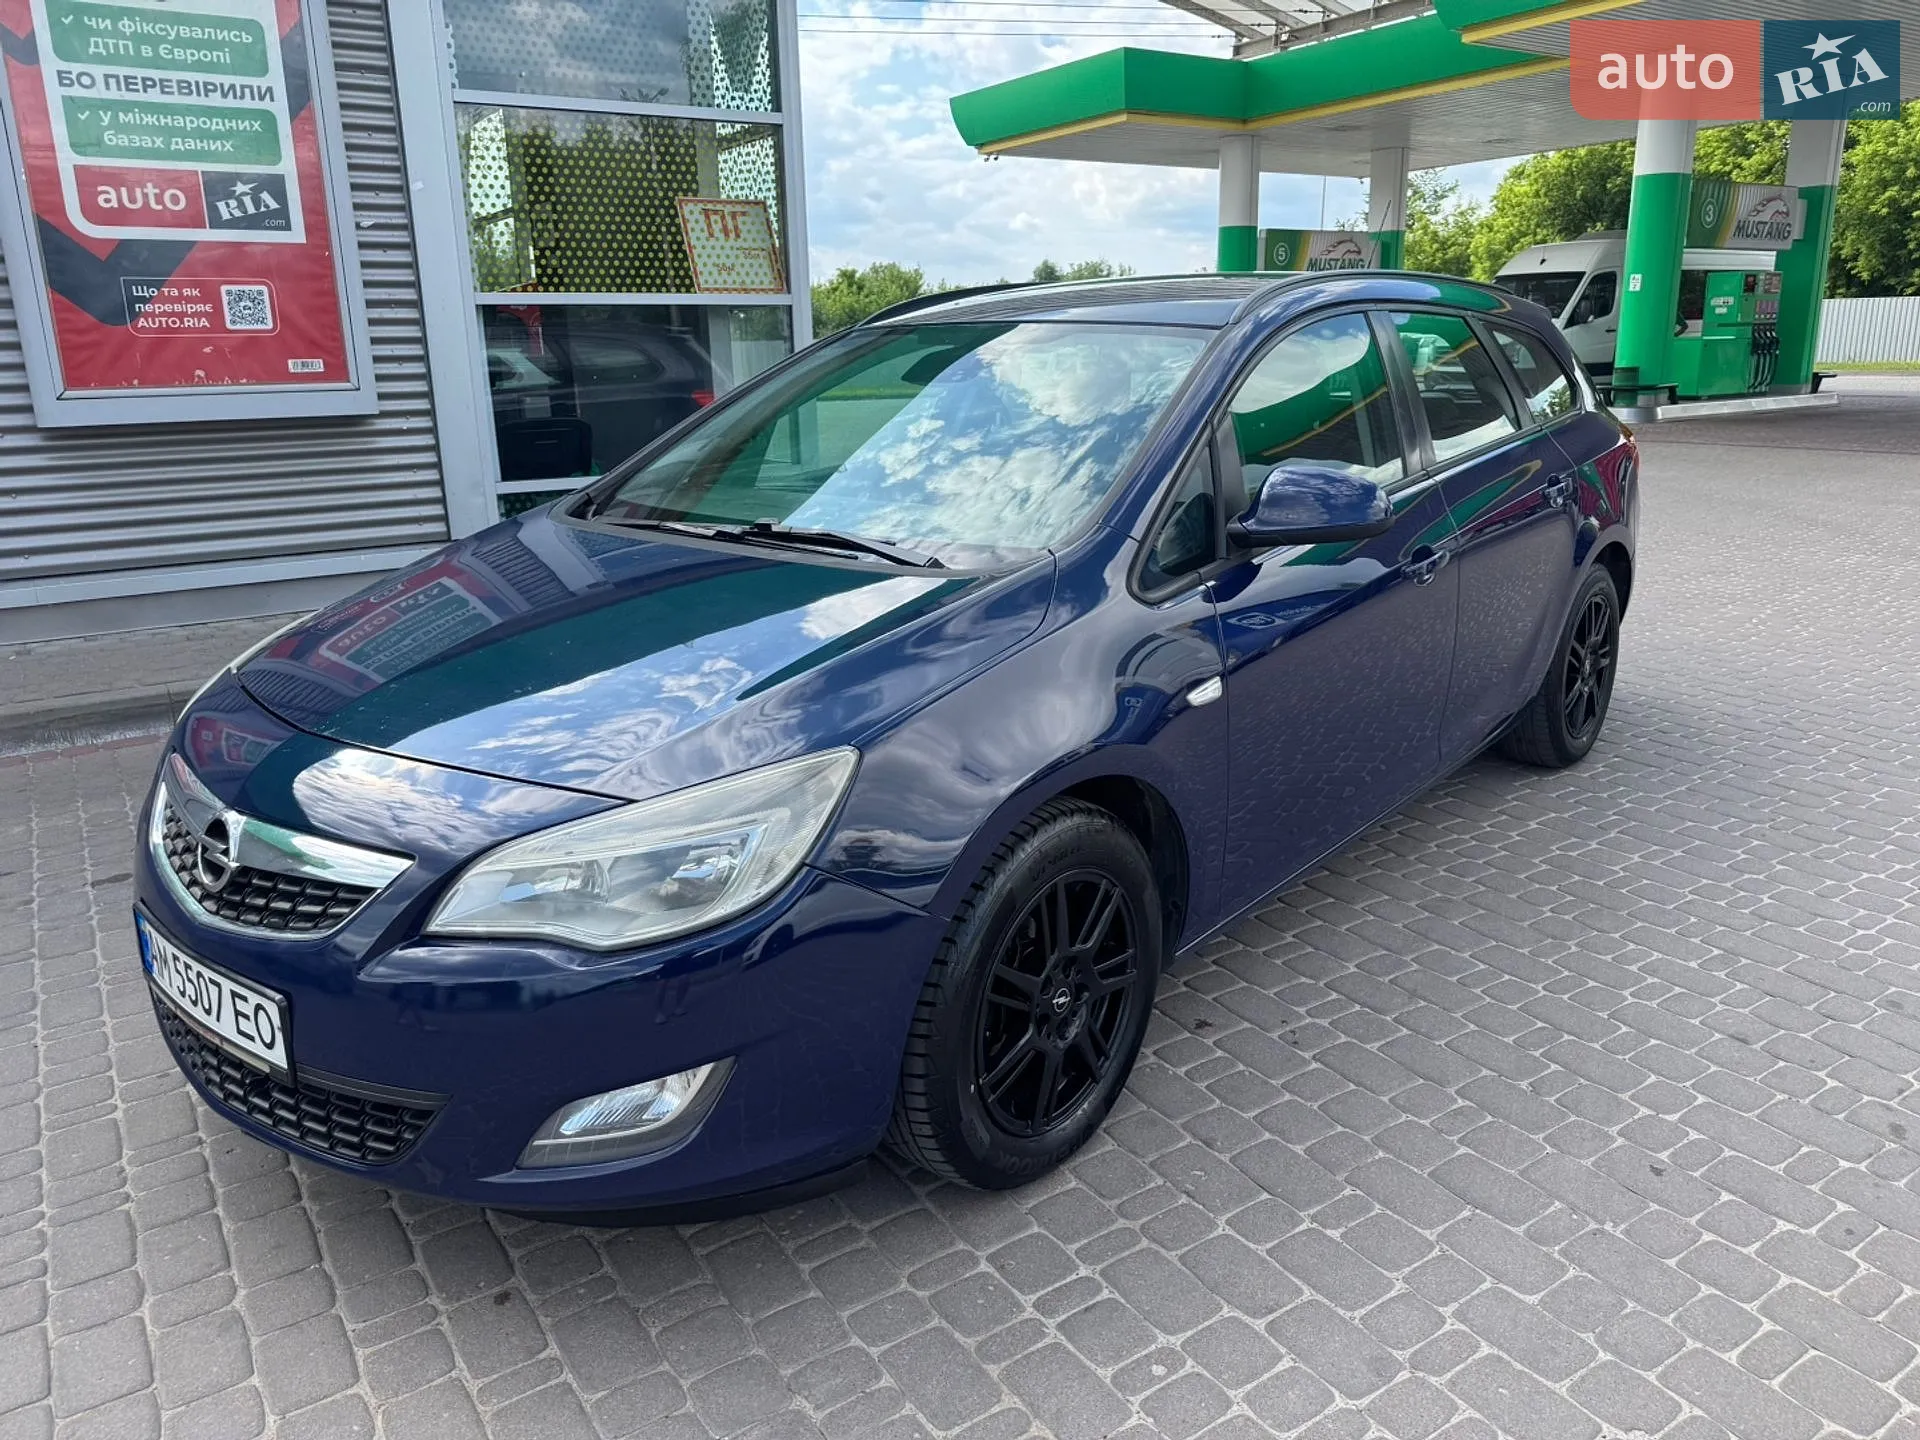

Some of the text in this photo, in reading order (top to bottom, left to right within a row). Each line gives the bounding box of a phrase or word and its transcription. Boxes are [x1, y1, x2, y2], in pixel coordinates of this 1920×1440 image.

[84, 15, 253, 44] чи фіксувались
[88, 37, 231, 65] ДТП в Європі
[57, 69, 276, 103] БО ПЕРЕВІРИЛИ
[99, 108, 264, 132] у міжнародних
[103, 131, 235, 152] базах даних
[96, 182, 188, 211] auto
[215, 190, 281, 222] RIA
[1705, 204, 1715, 223] 3
[1732, 219, 1793, 241] MUSTANG
[1278, 247, 1286, 261] 5
[1306, 257, 1366, 272] MUSTANG
[132, 285, 201, 298] Що та як
[134, 301, 214, 314] перевіряє
[137, 317, 211, 328] AUTO.RIA
[172, 952, 223, 1023] 5507
[229, 988, 276, 1051] EO
